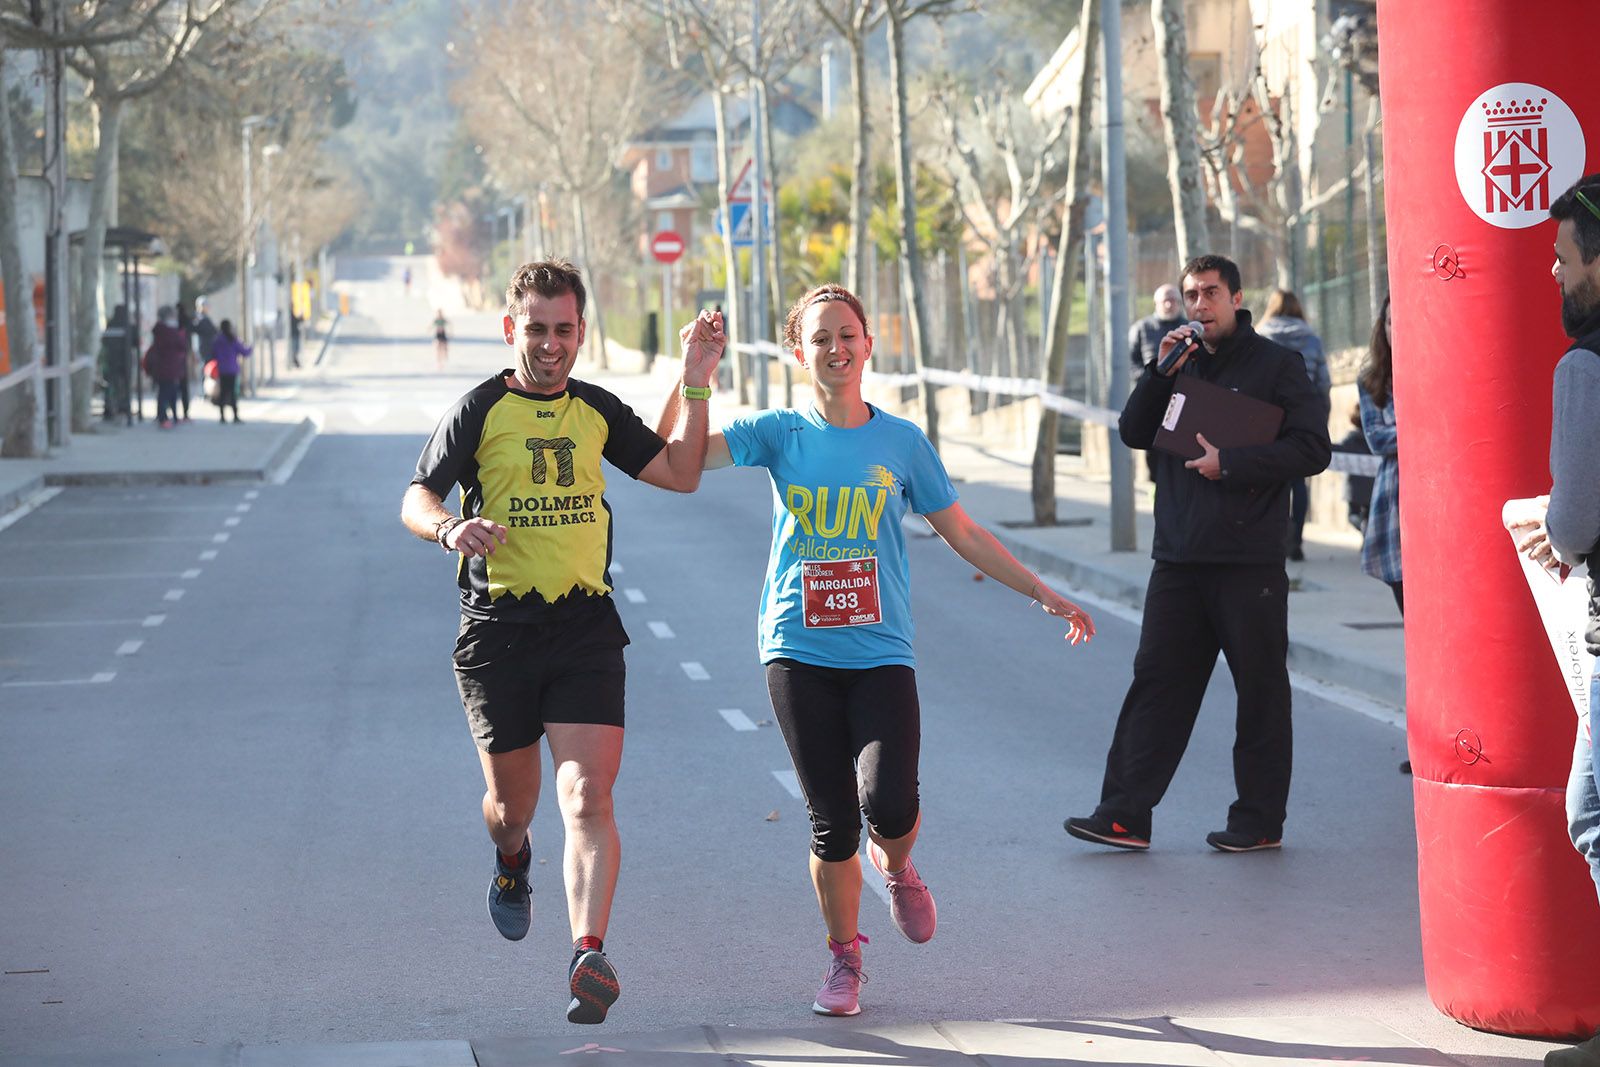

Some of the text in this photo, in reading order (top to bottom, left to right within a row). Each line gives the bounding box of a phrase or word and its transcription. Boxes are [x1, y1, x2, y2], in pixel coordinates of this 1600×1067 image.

[508, 494, 595, 512] DOLMEN
[508, 512, 596, 528] TRAIL RACE
[786, 484, 887, 541] RUN
[809, 576, 871, 591] MARGALIDA
[824, 592, 859, 610] 433
